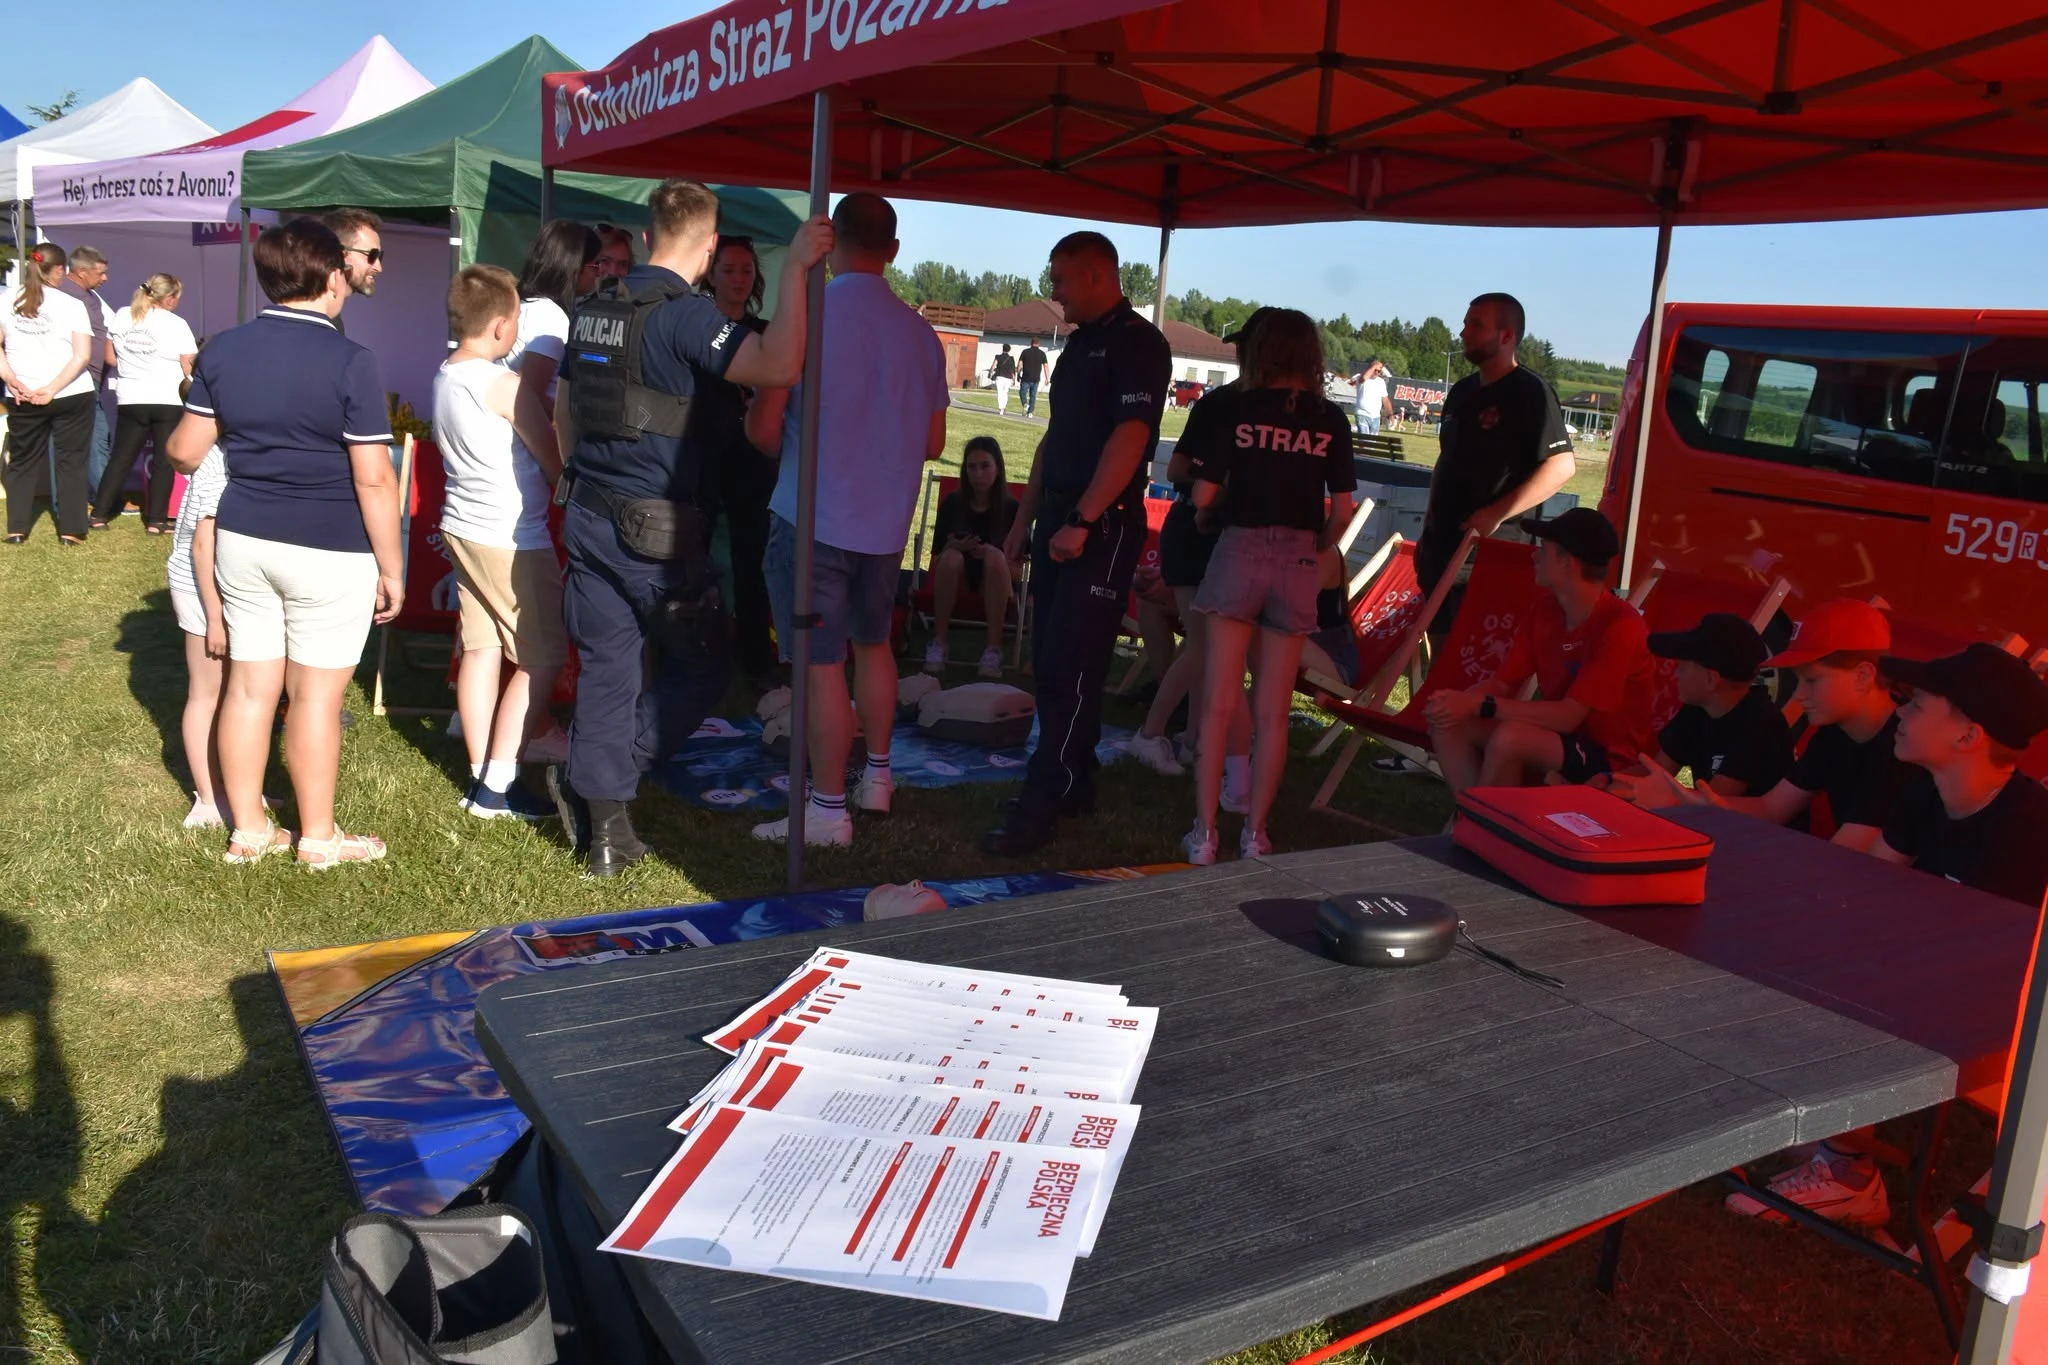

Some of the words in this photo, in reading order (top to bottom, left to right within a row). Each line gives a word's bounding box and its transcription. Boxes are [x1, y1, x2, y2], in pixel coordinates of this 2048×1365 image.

[573, 47, 700, 136] Ochotnicza
[708, 0, 794, 92] Straż
[63, 177, 89, 206] Hej,
[92, 175, 136, 199] chcesz
[139, 171, 163, 197] coś
[166, 178, 175, 197] z
[178, 170, 235, 198] Avonu?
[573, 315, 625, 348] POLICJA
[1394, 384, 1447, 405] BREAK
[1069, 1114, 1099, 1148] POLS
[1089, 1116, 1118, 1150] BEZPI
[1026, 1160, 1061, 1209] POLSKA
[1037, 1162, 1081, 1238] BEZPIECZNA
